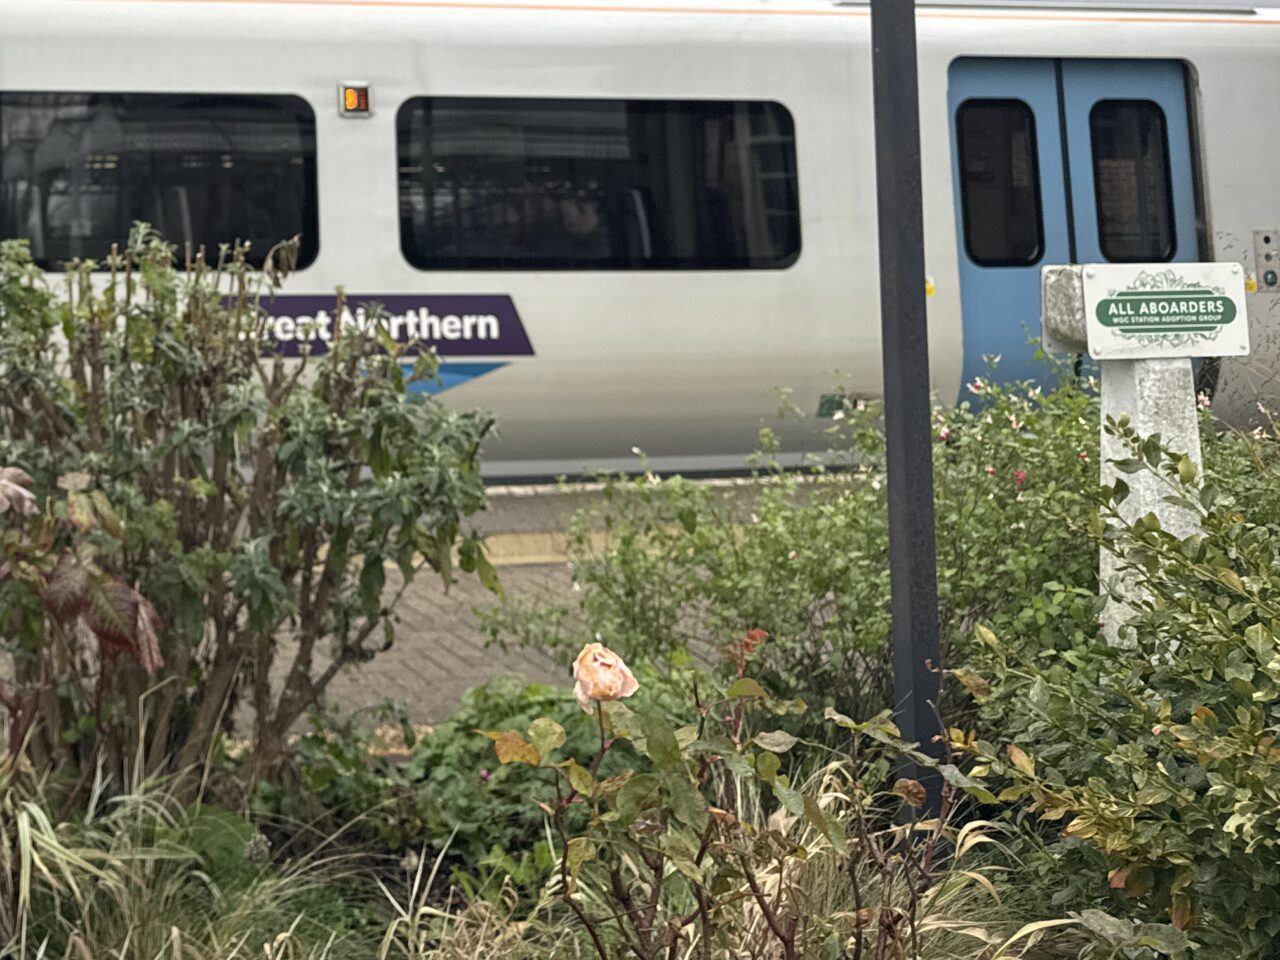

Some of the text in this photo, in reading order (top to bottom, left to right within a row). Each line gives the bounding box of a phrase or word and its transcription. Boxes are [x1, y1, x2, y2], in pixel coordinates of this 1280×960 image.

[1108, 300, 1224, 315] ALL ABOARDERS
[237, 308, 332, 341] reat
[1131, 315, 1160, 324] STATION
[1161, 314, 1197, 323] ADOPTION
[1198, 314, 1222, 322] GROUP
